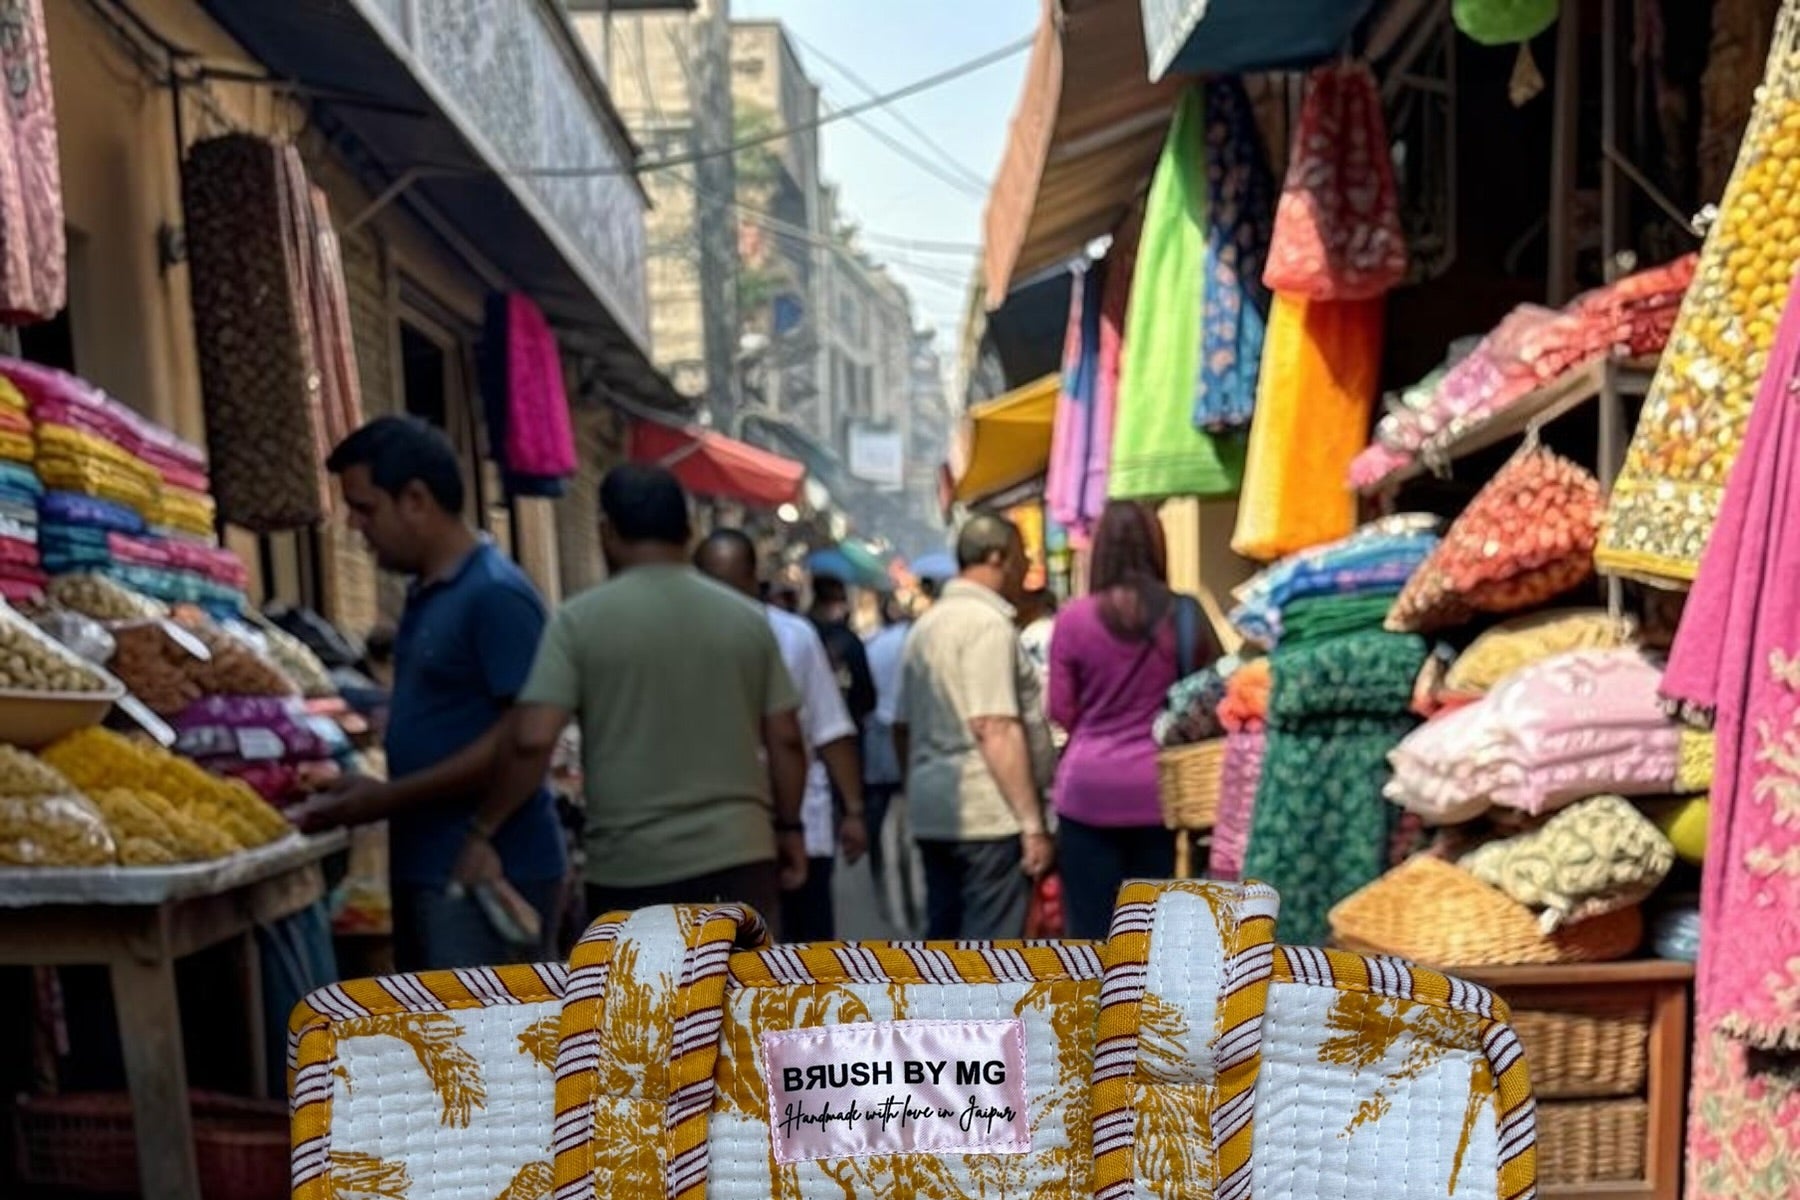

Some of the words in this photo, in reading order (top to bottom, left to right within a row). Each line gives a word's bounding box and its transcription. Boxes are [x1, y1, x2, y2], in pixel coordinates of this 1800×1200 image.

[903, 1061, 947, 1085] BY
[955, 1061, 1006, 1085] MG
[778, 1100, 862, 1138] Handmade
[865, 1095, 903, 1132] with
[902, 1094, 934, 1128] love
[937, 1106, 955, 1119] in
[958, 1094, 1017, 1134] Jaipur
